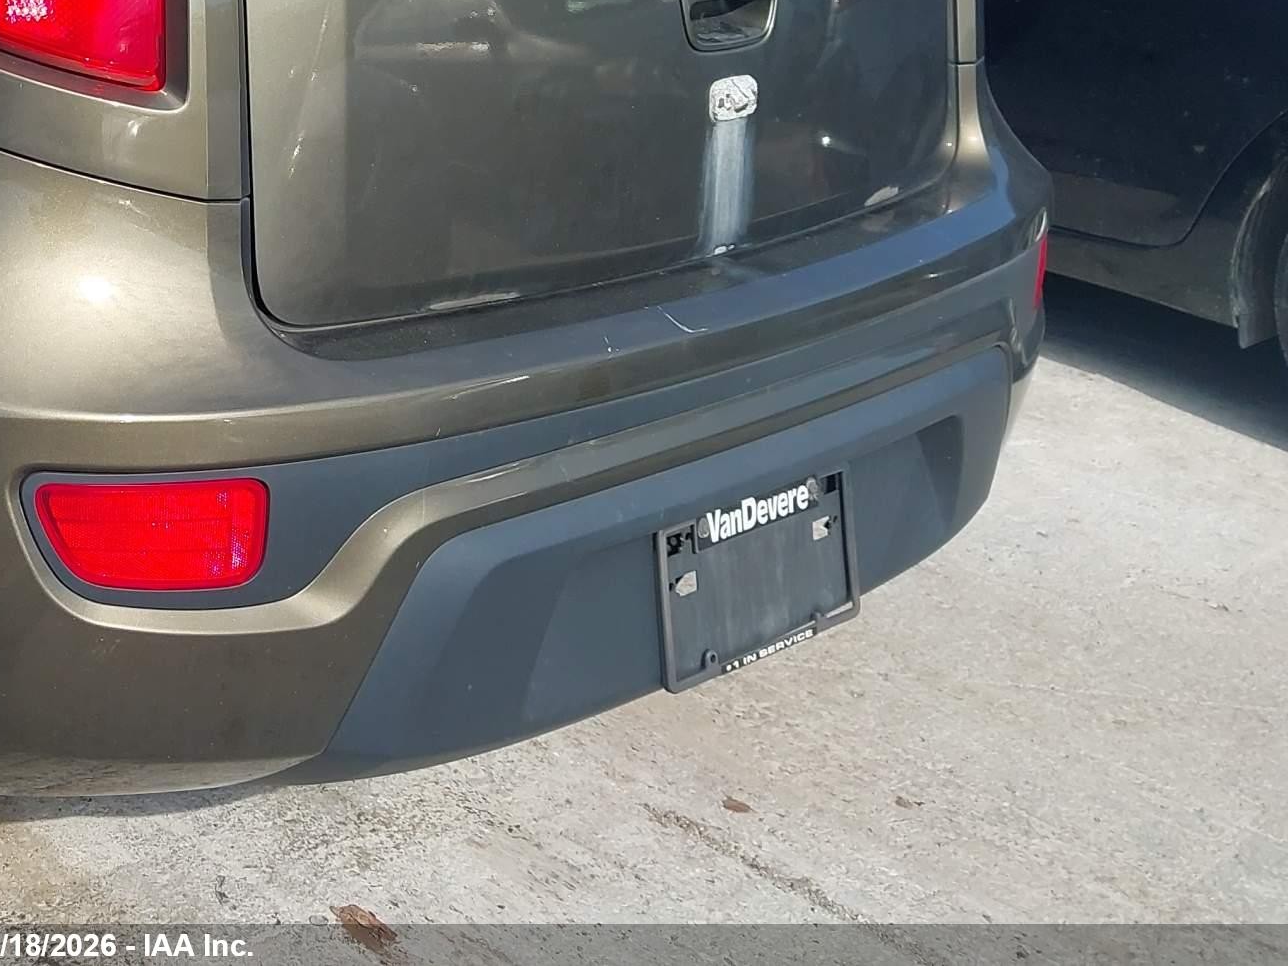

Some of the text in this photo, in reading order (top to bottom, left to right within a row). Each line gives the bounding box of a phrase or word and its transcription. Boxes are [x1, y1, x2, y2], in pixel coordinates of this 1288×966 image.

[706, 484, 810, 544] VanDevere
[742, 652, 757, 665] IN
[758, 629, 814, 658] SERVICE
